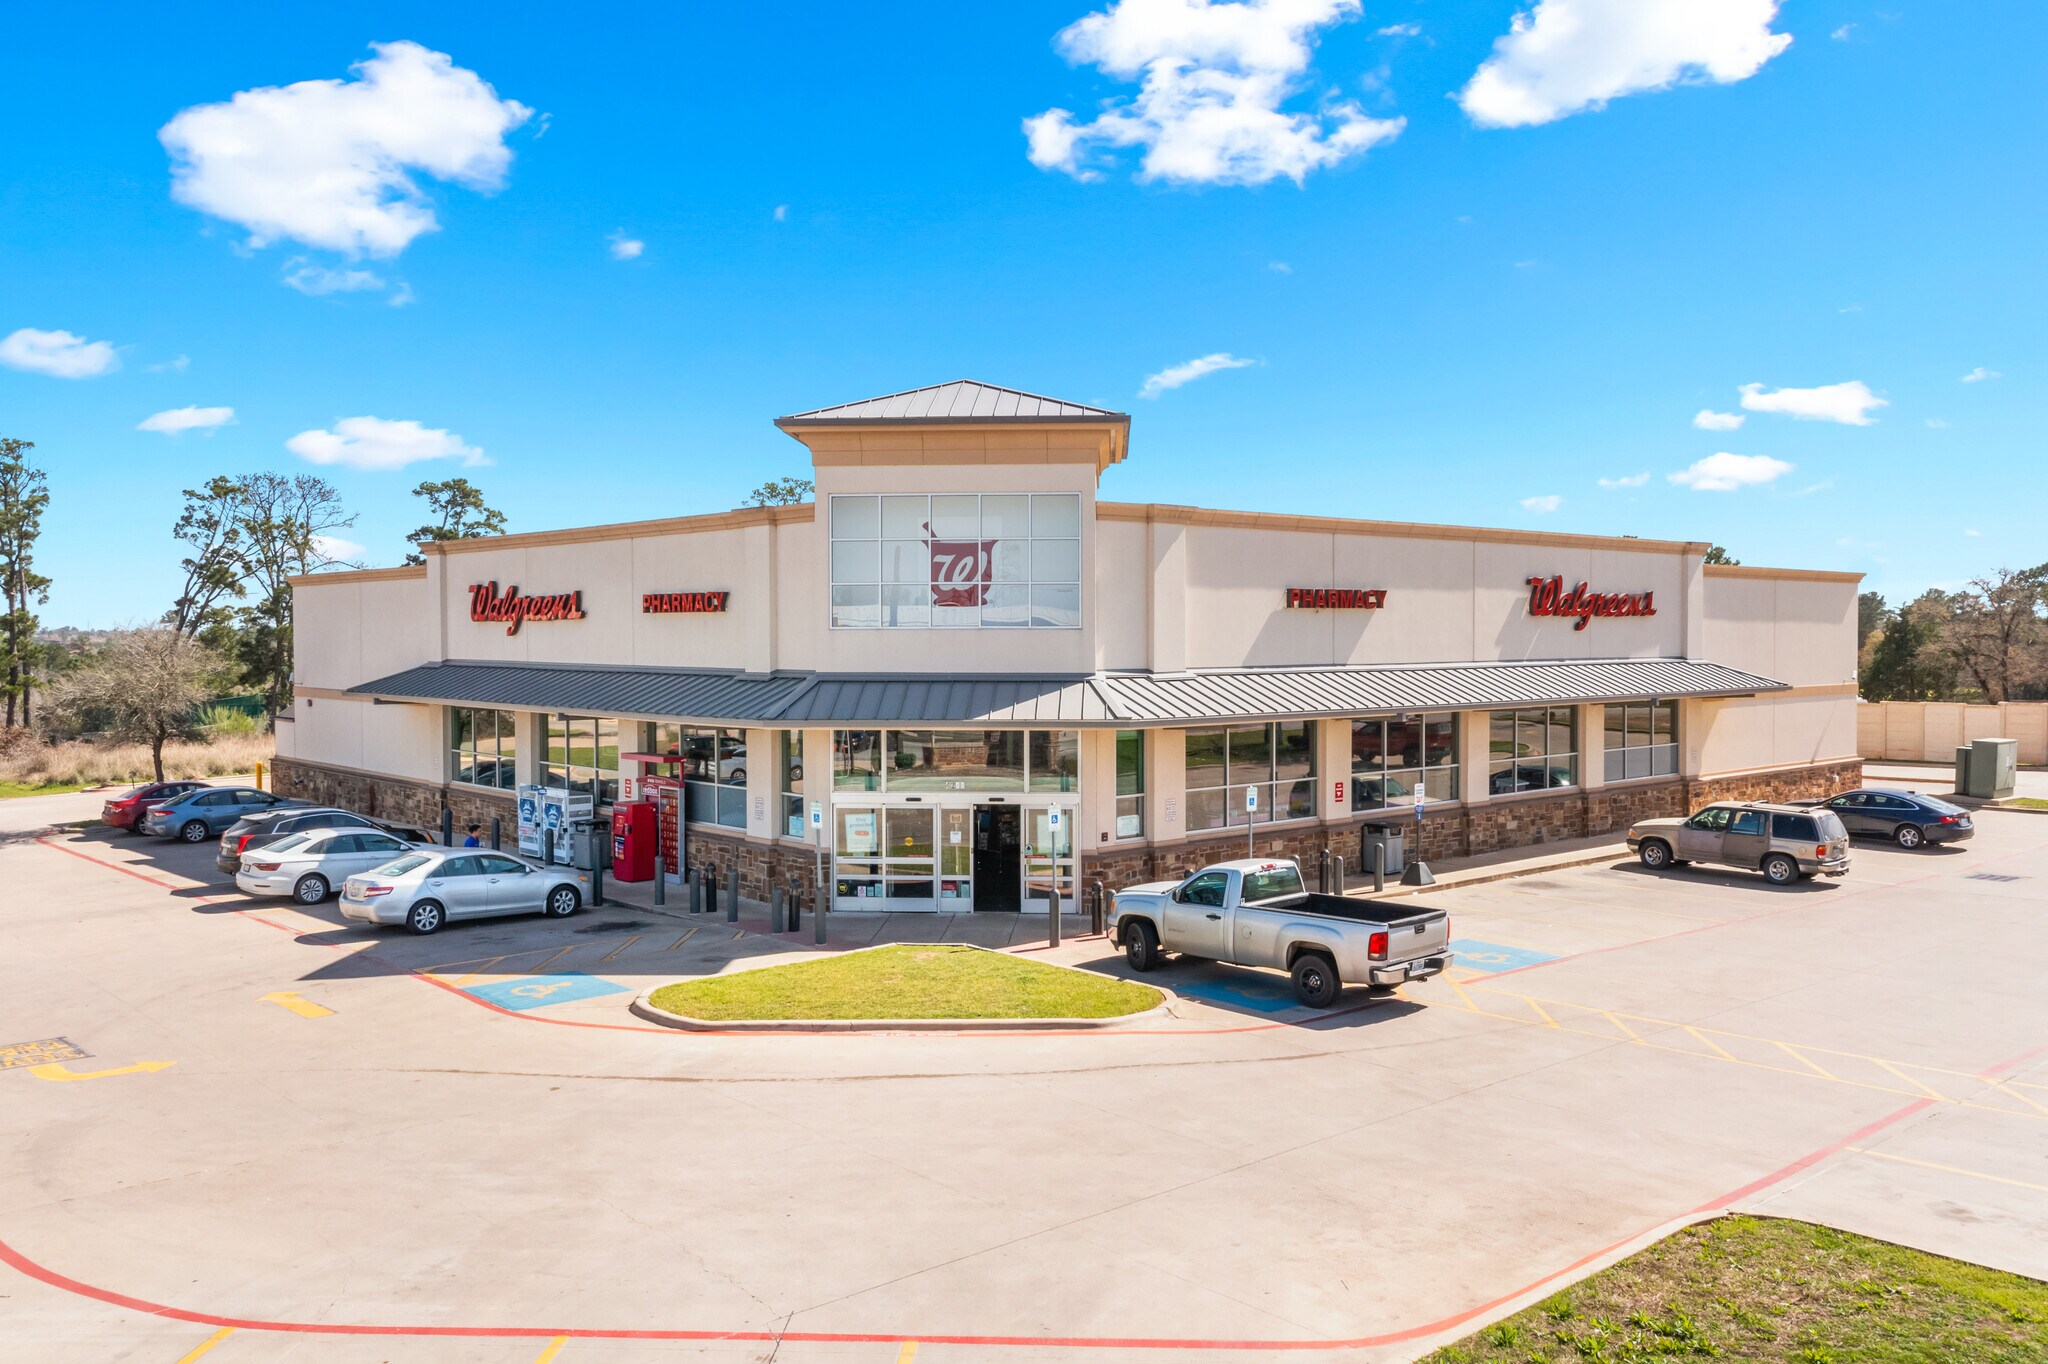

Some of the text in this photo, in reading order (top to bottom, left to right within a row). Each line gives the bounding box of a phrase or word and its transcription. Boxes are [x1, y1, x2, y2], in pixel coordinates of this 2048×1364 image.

[468, 581, 587, 637] Walgreens
[642, 591, 730, 613] PHARMACY
[1286, 588, 1388, 609] PHARMACY
[1526, 574, 1657, 631] Walgreens
